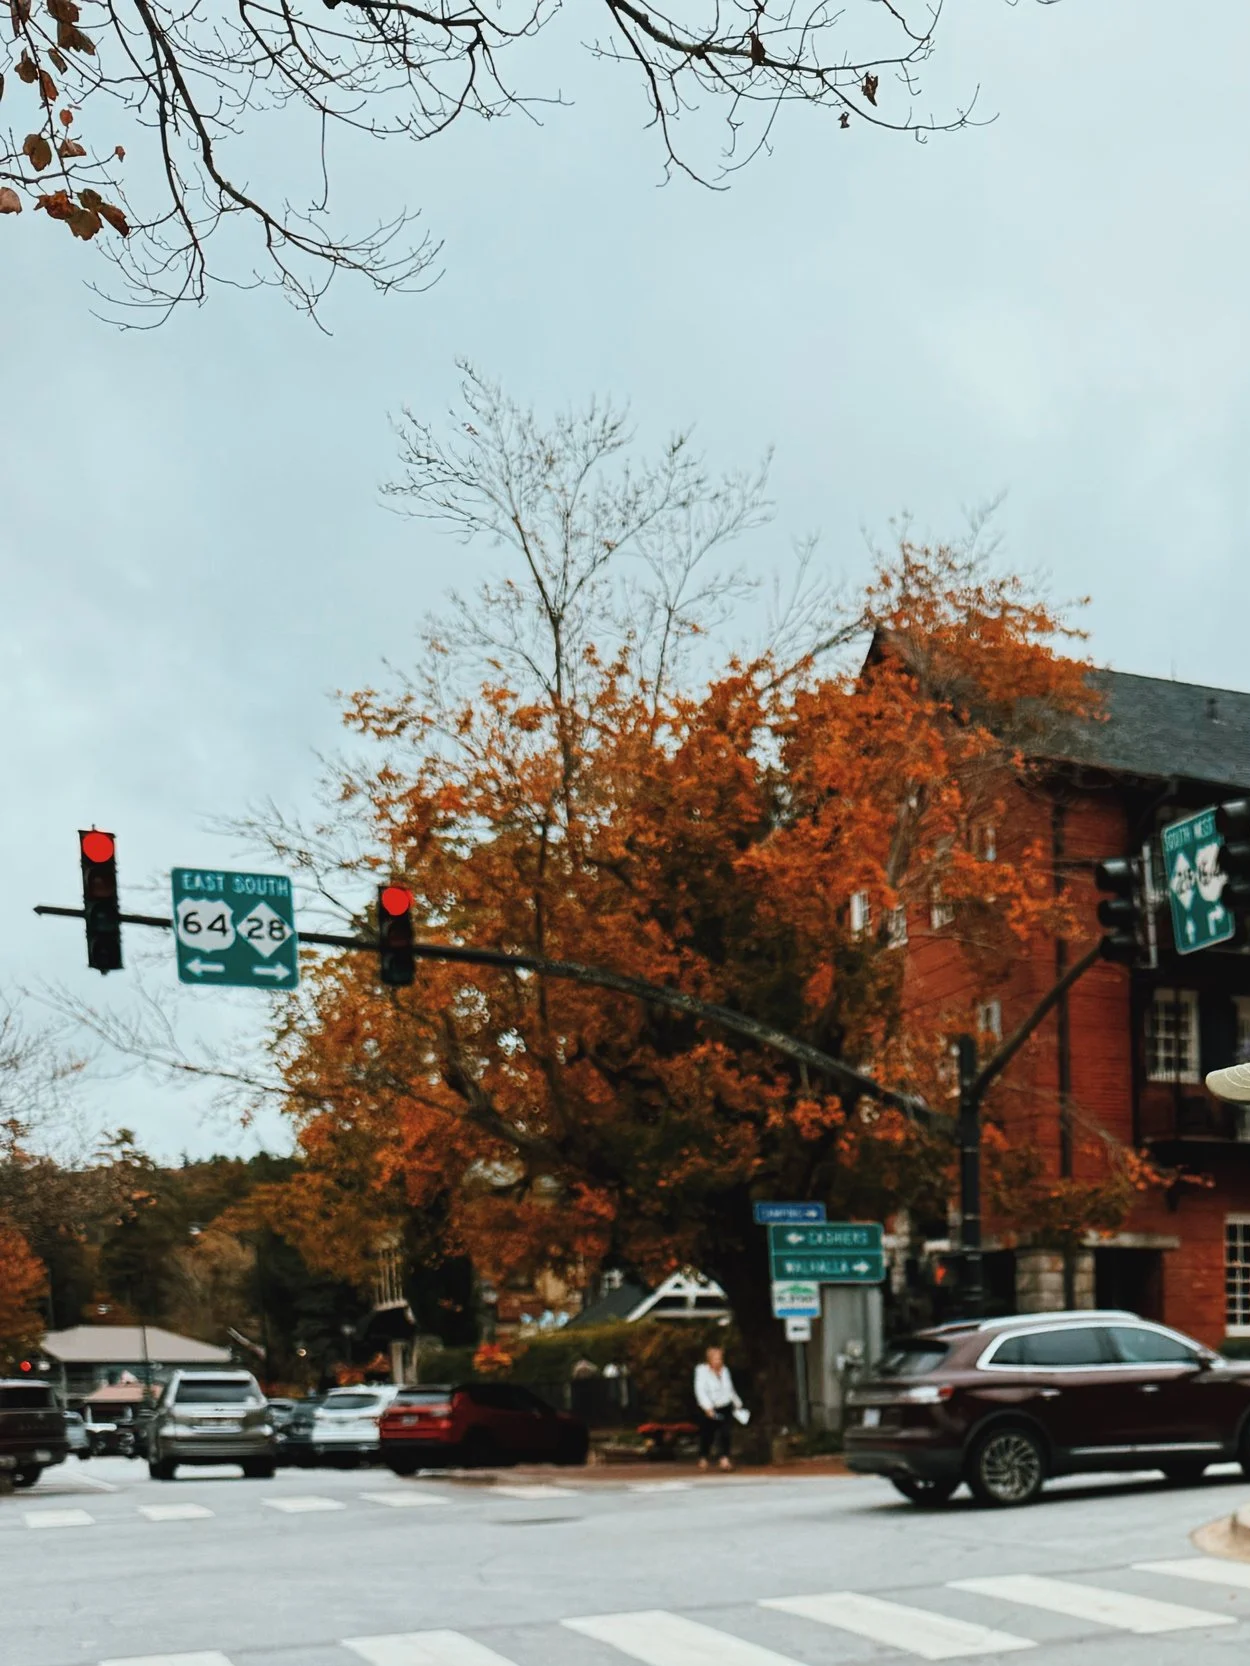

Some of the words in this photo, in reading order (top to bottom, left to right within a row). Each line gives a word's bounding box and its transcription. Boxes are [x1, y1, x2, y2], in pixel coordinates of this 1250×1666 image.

[182, 873, 225, 892] EAST
[232, 876, 290, 897] SOUTH
[182, 911, 229, 937] 64
[247, 917, 286, 941] 28
[807, 1231, 869, 1246] CASHIERS
